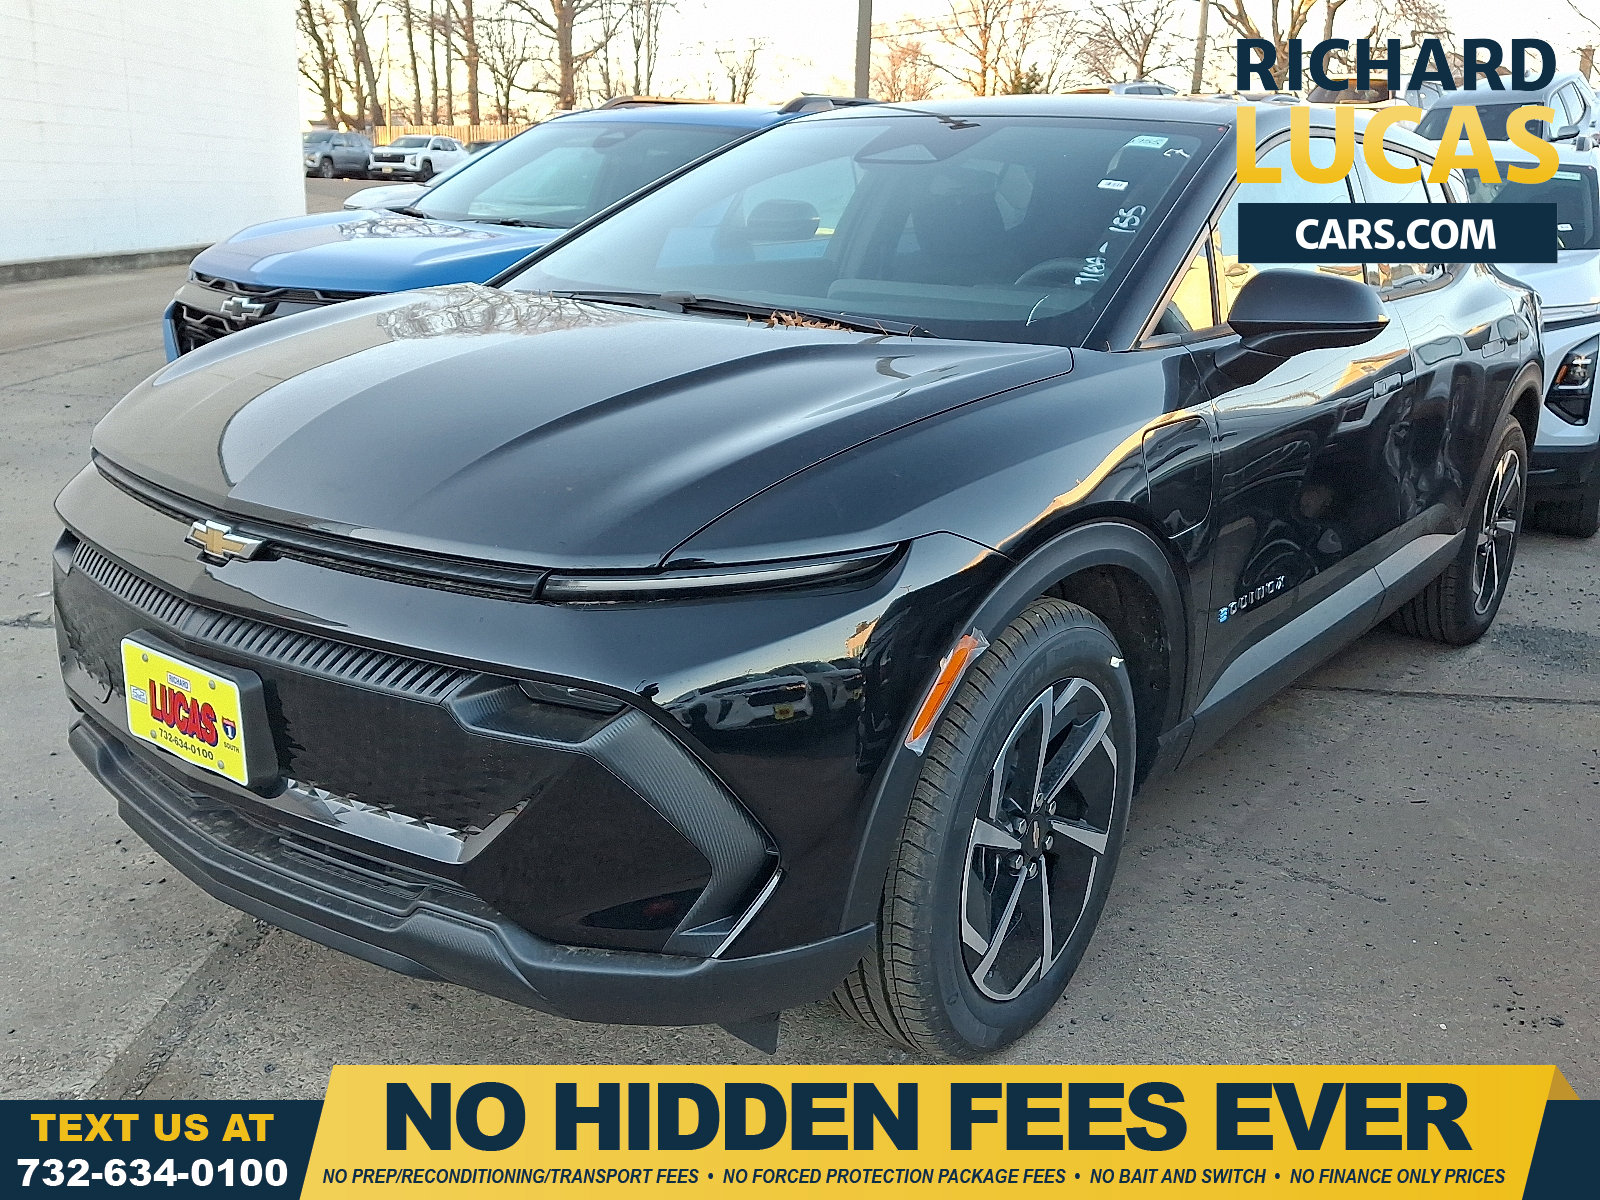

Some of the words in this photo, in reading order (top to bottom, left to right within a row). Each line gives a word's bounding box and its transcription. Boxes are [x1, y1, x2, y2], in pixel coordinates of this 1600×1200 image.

[1217, 575, 1286, 623] EQUINOX
[168, 674, 190, 690] RICHARD
[149, 678, 218, 747] LUCAS
[159, 727, 214, 760] 732-634-0100
[223, 741, 240, 753] SOUTH
